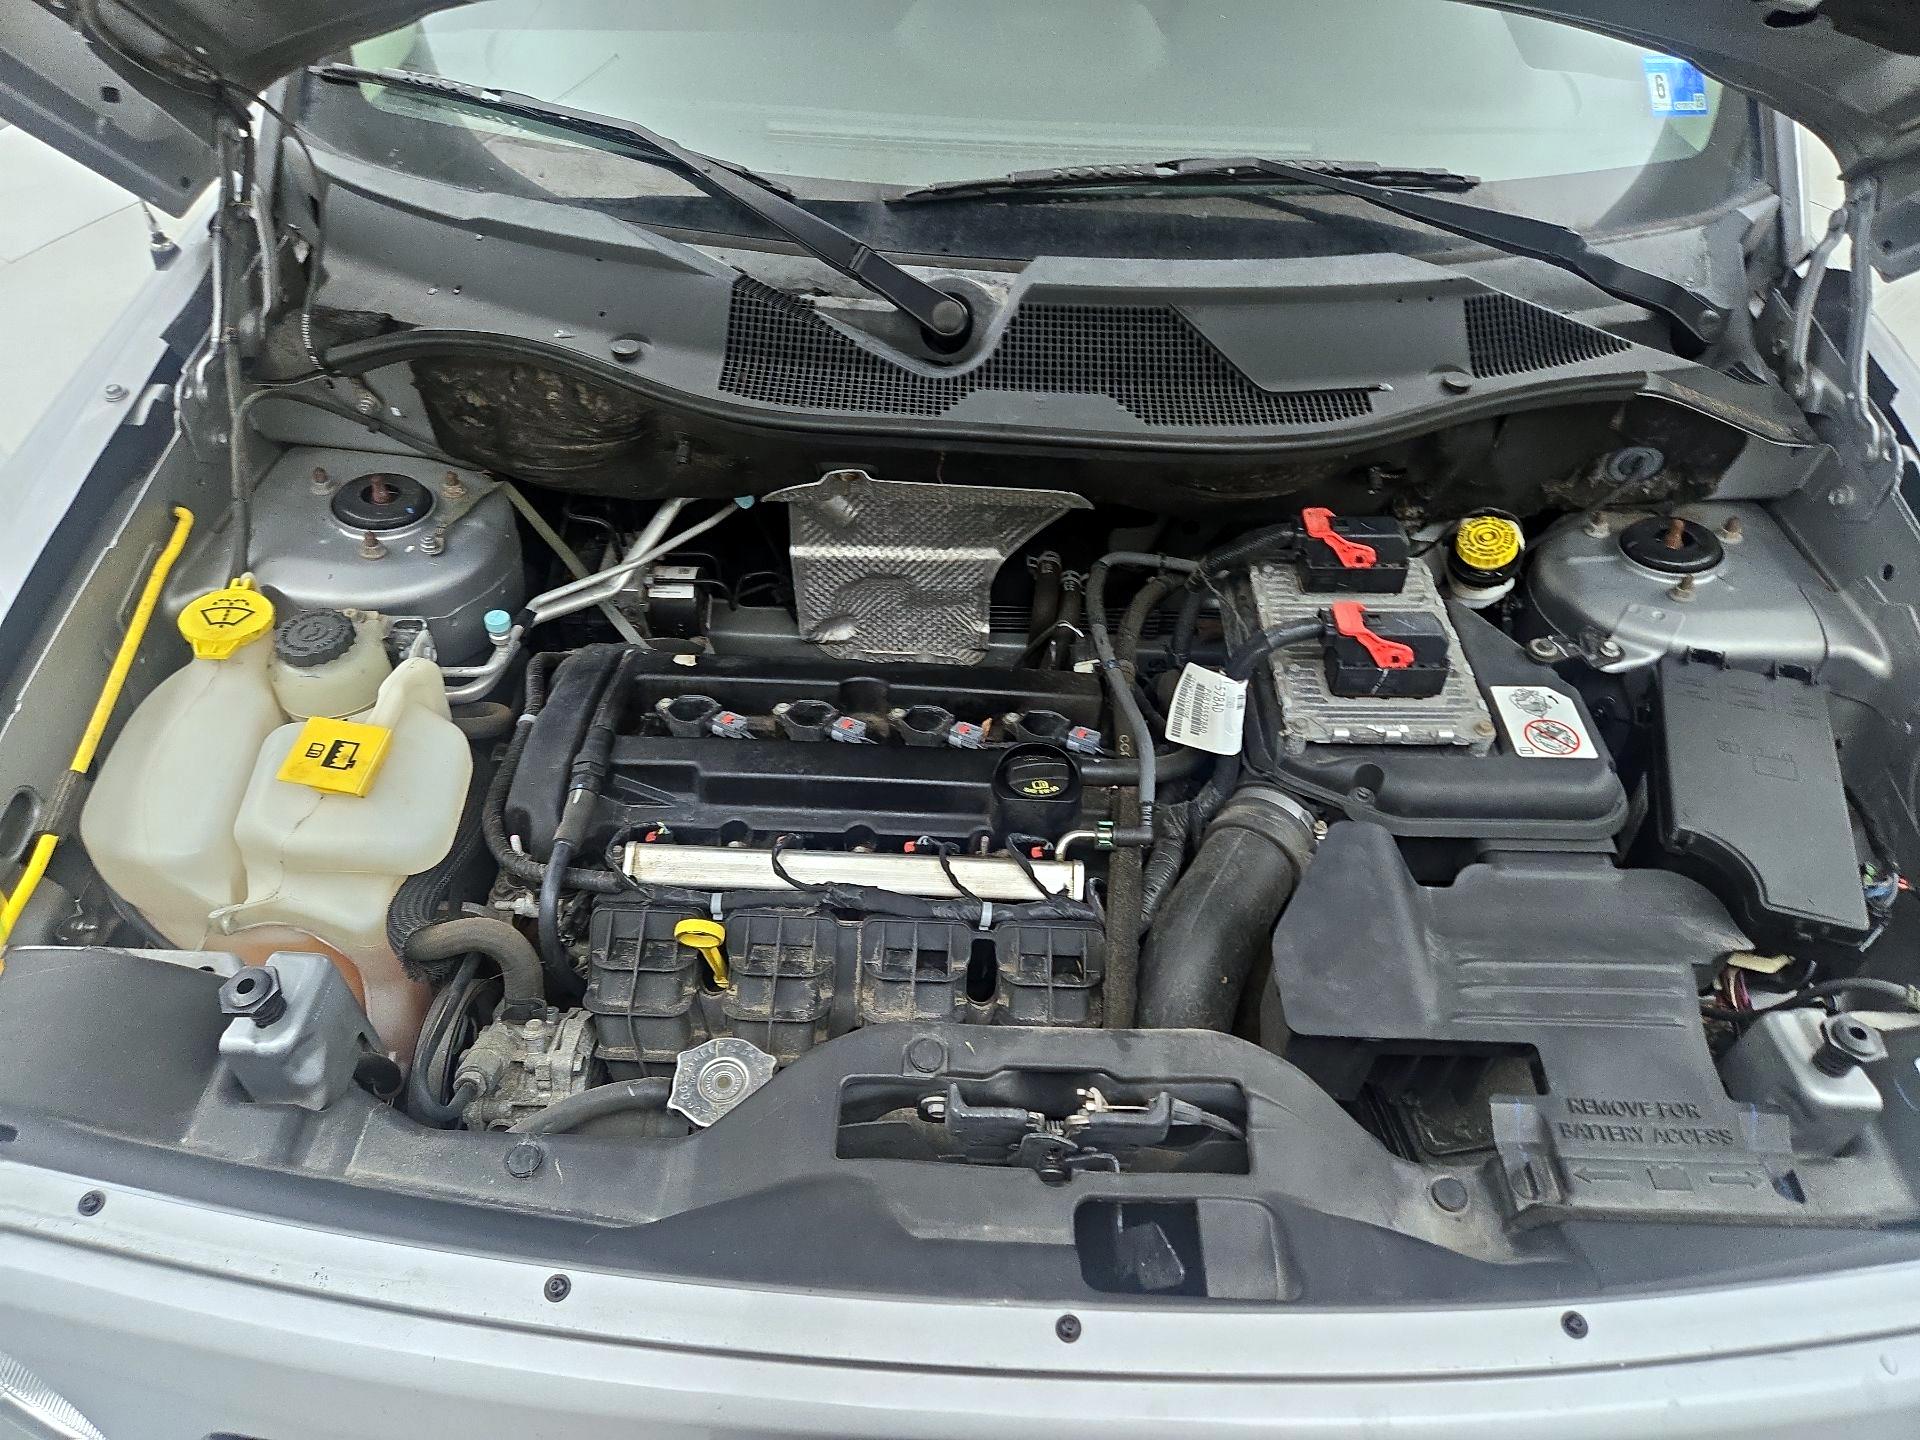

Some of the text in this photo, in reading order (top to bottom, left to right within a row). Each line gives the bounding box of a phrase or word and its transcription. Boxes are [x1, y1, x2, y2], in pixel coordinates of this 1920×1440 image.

[1655, 74, 1666, 99] 6
[1212, 684, 1226, 713] 578AD
[1567, 1098, 1701, 1119] REMOVE FOR
[1558, 1121, 1733, 1145] BATTERY ACCESS
